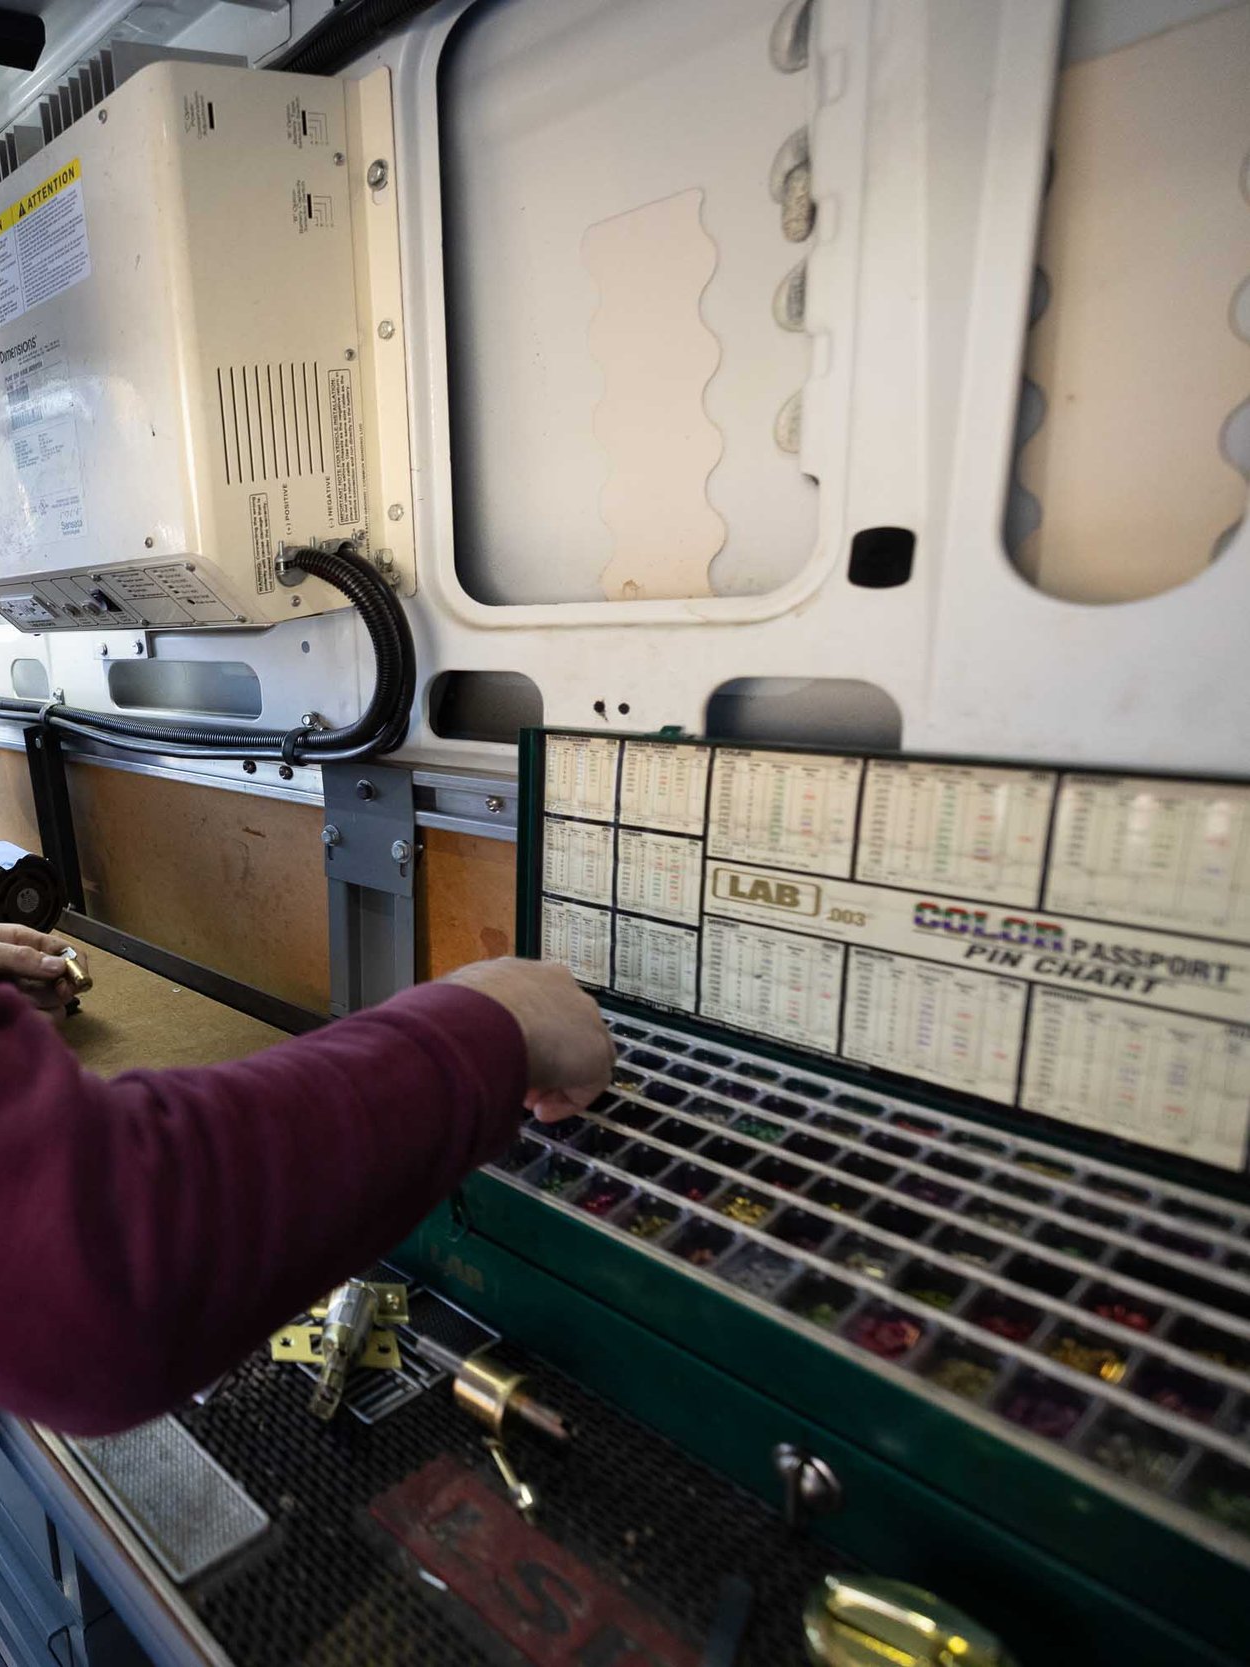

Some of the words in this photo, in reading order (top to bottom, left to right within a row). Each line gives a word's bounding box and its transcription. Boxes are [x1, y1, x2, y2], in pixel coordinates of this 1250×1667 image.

[27, 166, 75, 210] ATTENTION
[282, 483, 290, 520] POSITIVE
[324, 476, 333, 516] NEGATIVE
[728, 874, 800, 908] LAB
[913, 901, 1065, 951] COLOR
[1070, 938, 1231, 983] PASSPORT
[963, 943, 1022, 968] PIN
[1033, 957, 1158, 994] CHART
